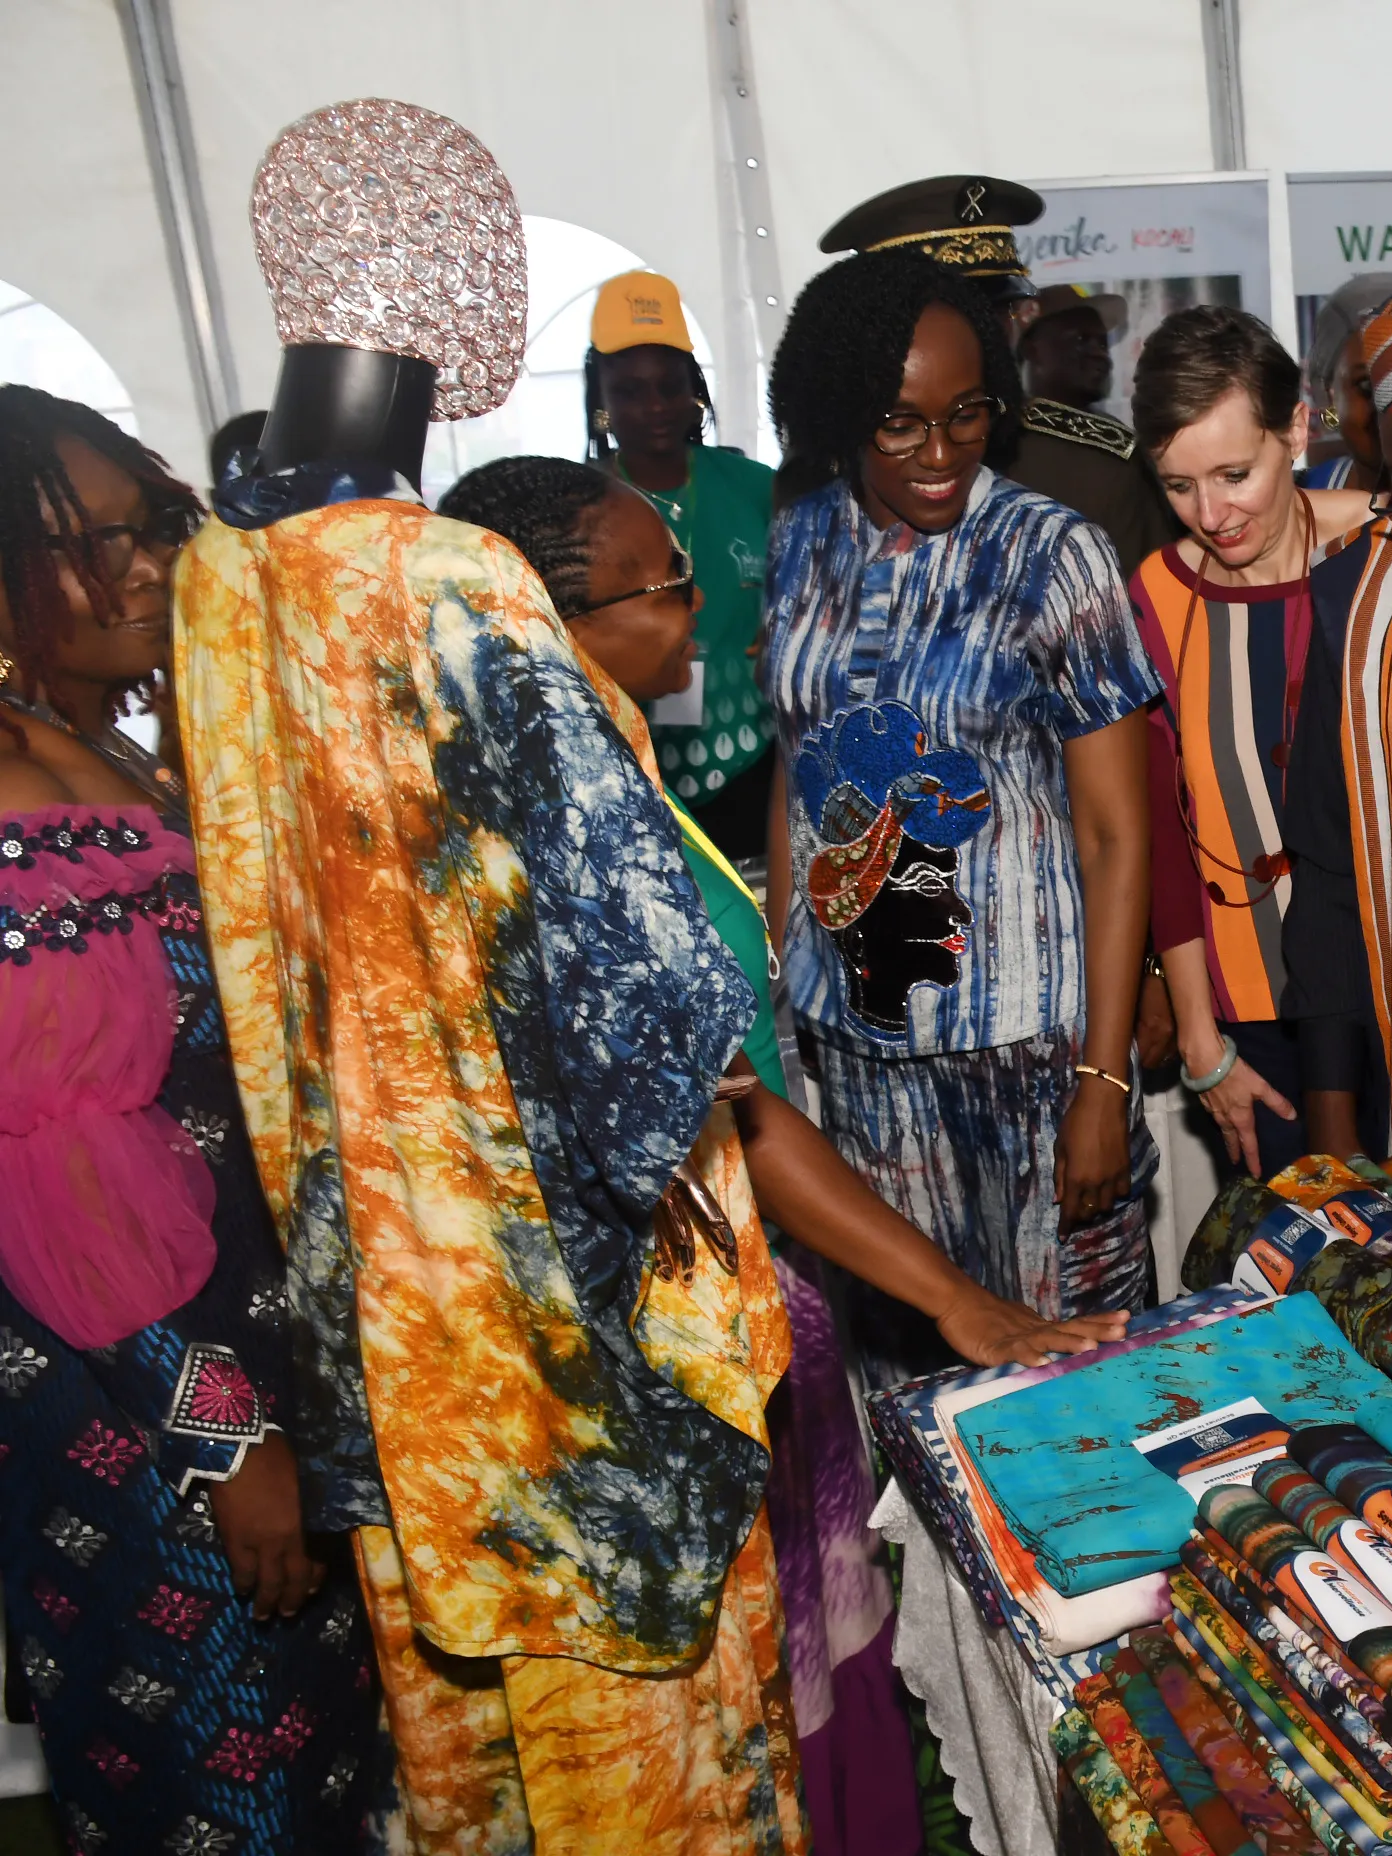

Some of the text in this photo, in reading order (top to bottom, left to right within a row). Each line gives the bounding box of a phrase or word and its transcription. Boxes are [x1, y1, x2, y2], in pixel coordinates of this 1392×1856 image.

[1178, 1428, 1196, 1436] code
[1204, 1462, 1261, 1484] Merveilleuse
[1327, 1582, 1366, 1616] Merveilleuse
